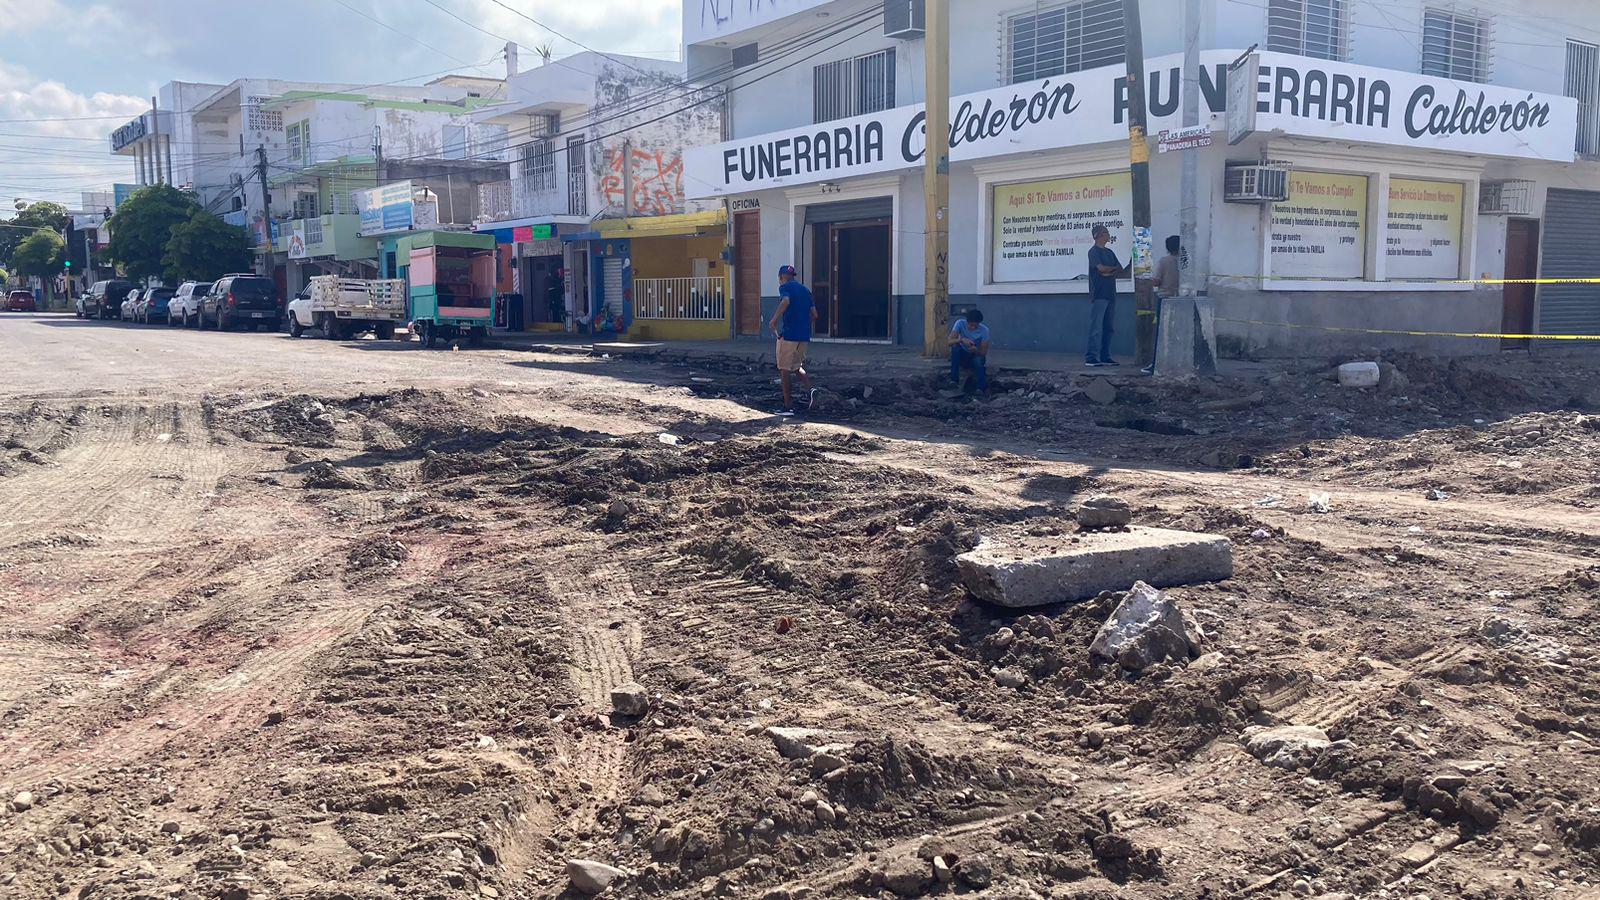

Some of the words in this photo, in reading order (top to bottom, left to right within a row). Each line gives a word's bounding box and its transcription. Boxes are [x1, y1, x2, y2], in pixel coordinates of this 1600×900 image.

[1404, 84, 1550, 138] Calderón
[724, 120, 882, 184] FUNERARIA
[901, 80, 1081, 162] Clderón
[1198, 138, 1211, 146] TECO
[1036, 192, 1045, 203] Te
[1047, 190, 1073, 202] Vamos
[1082, 185, 1114, 200] Cumplir
[1296, 182, 1303, 193] Te
[1305, 181, 1325, 195] Vamos
[1327, 186, 1330, 195] a
[1331, 184, 1354, 199] Cumplir
[732, 198, 760, 210] OFICINA
[1003, 216, 1011, 224] Con
[1012, 214, 1030, 223] Nosotros
[1037, 213, 1045, 224] hay
[1067, 212, 1072, 220] ni
[1103, 208, 1120, 216] abusos
[1018, 225, 1032, 233] verdad
[1036, 222, 1060, 232] honestidad
[1060, 222, 1066, 230] de
[1066, 222, 1072, 230] 83
[1074, 221, 1084, 230] años
[1085, 220, 1091, 229] de
[1003, 240, 1020, 248] Contrata
[1027, 239, 1043, 247] nuestro
[1028, 249, 1033, 257] de
[1056, 248, 1074, 256] FAMILIA
